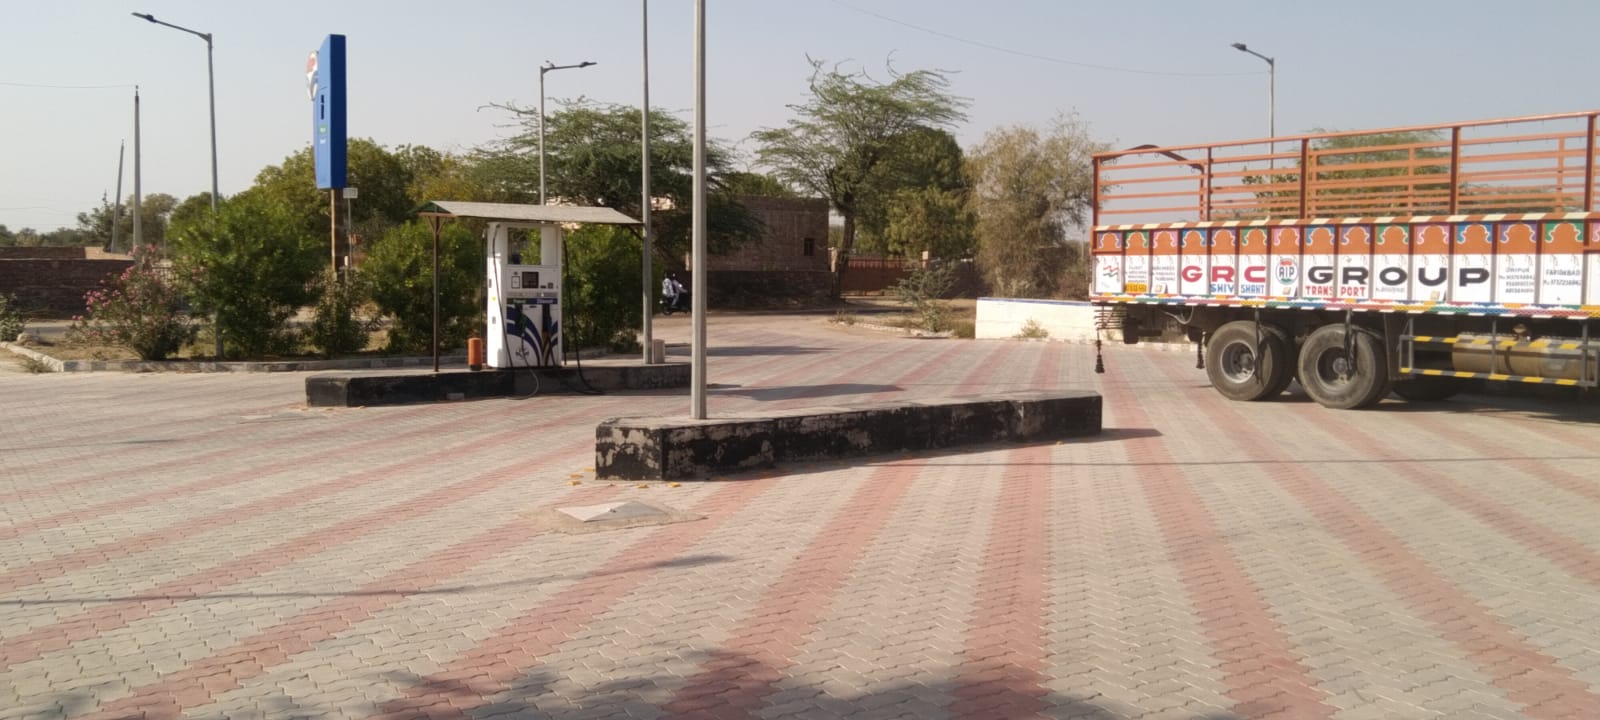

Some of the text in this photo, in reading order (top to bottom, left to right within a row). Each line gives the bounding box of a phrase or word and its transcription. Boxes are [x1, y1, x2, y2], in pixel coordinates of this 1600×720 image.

[1182, 265, 1266, 283] GRC
[1308, 266, 1489, 287] GROUP
[1210, 284, 1234, 293] SHIV
